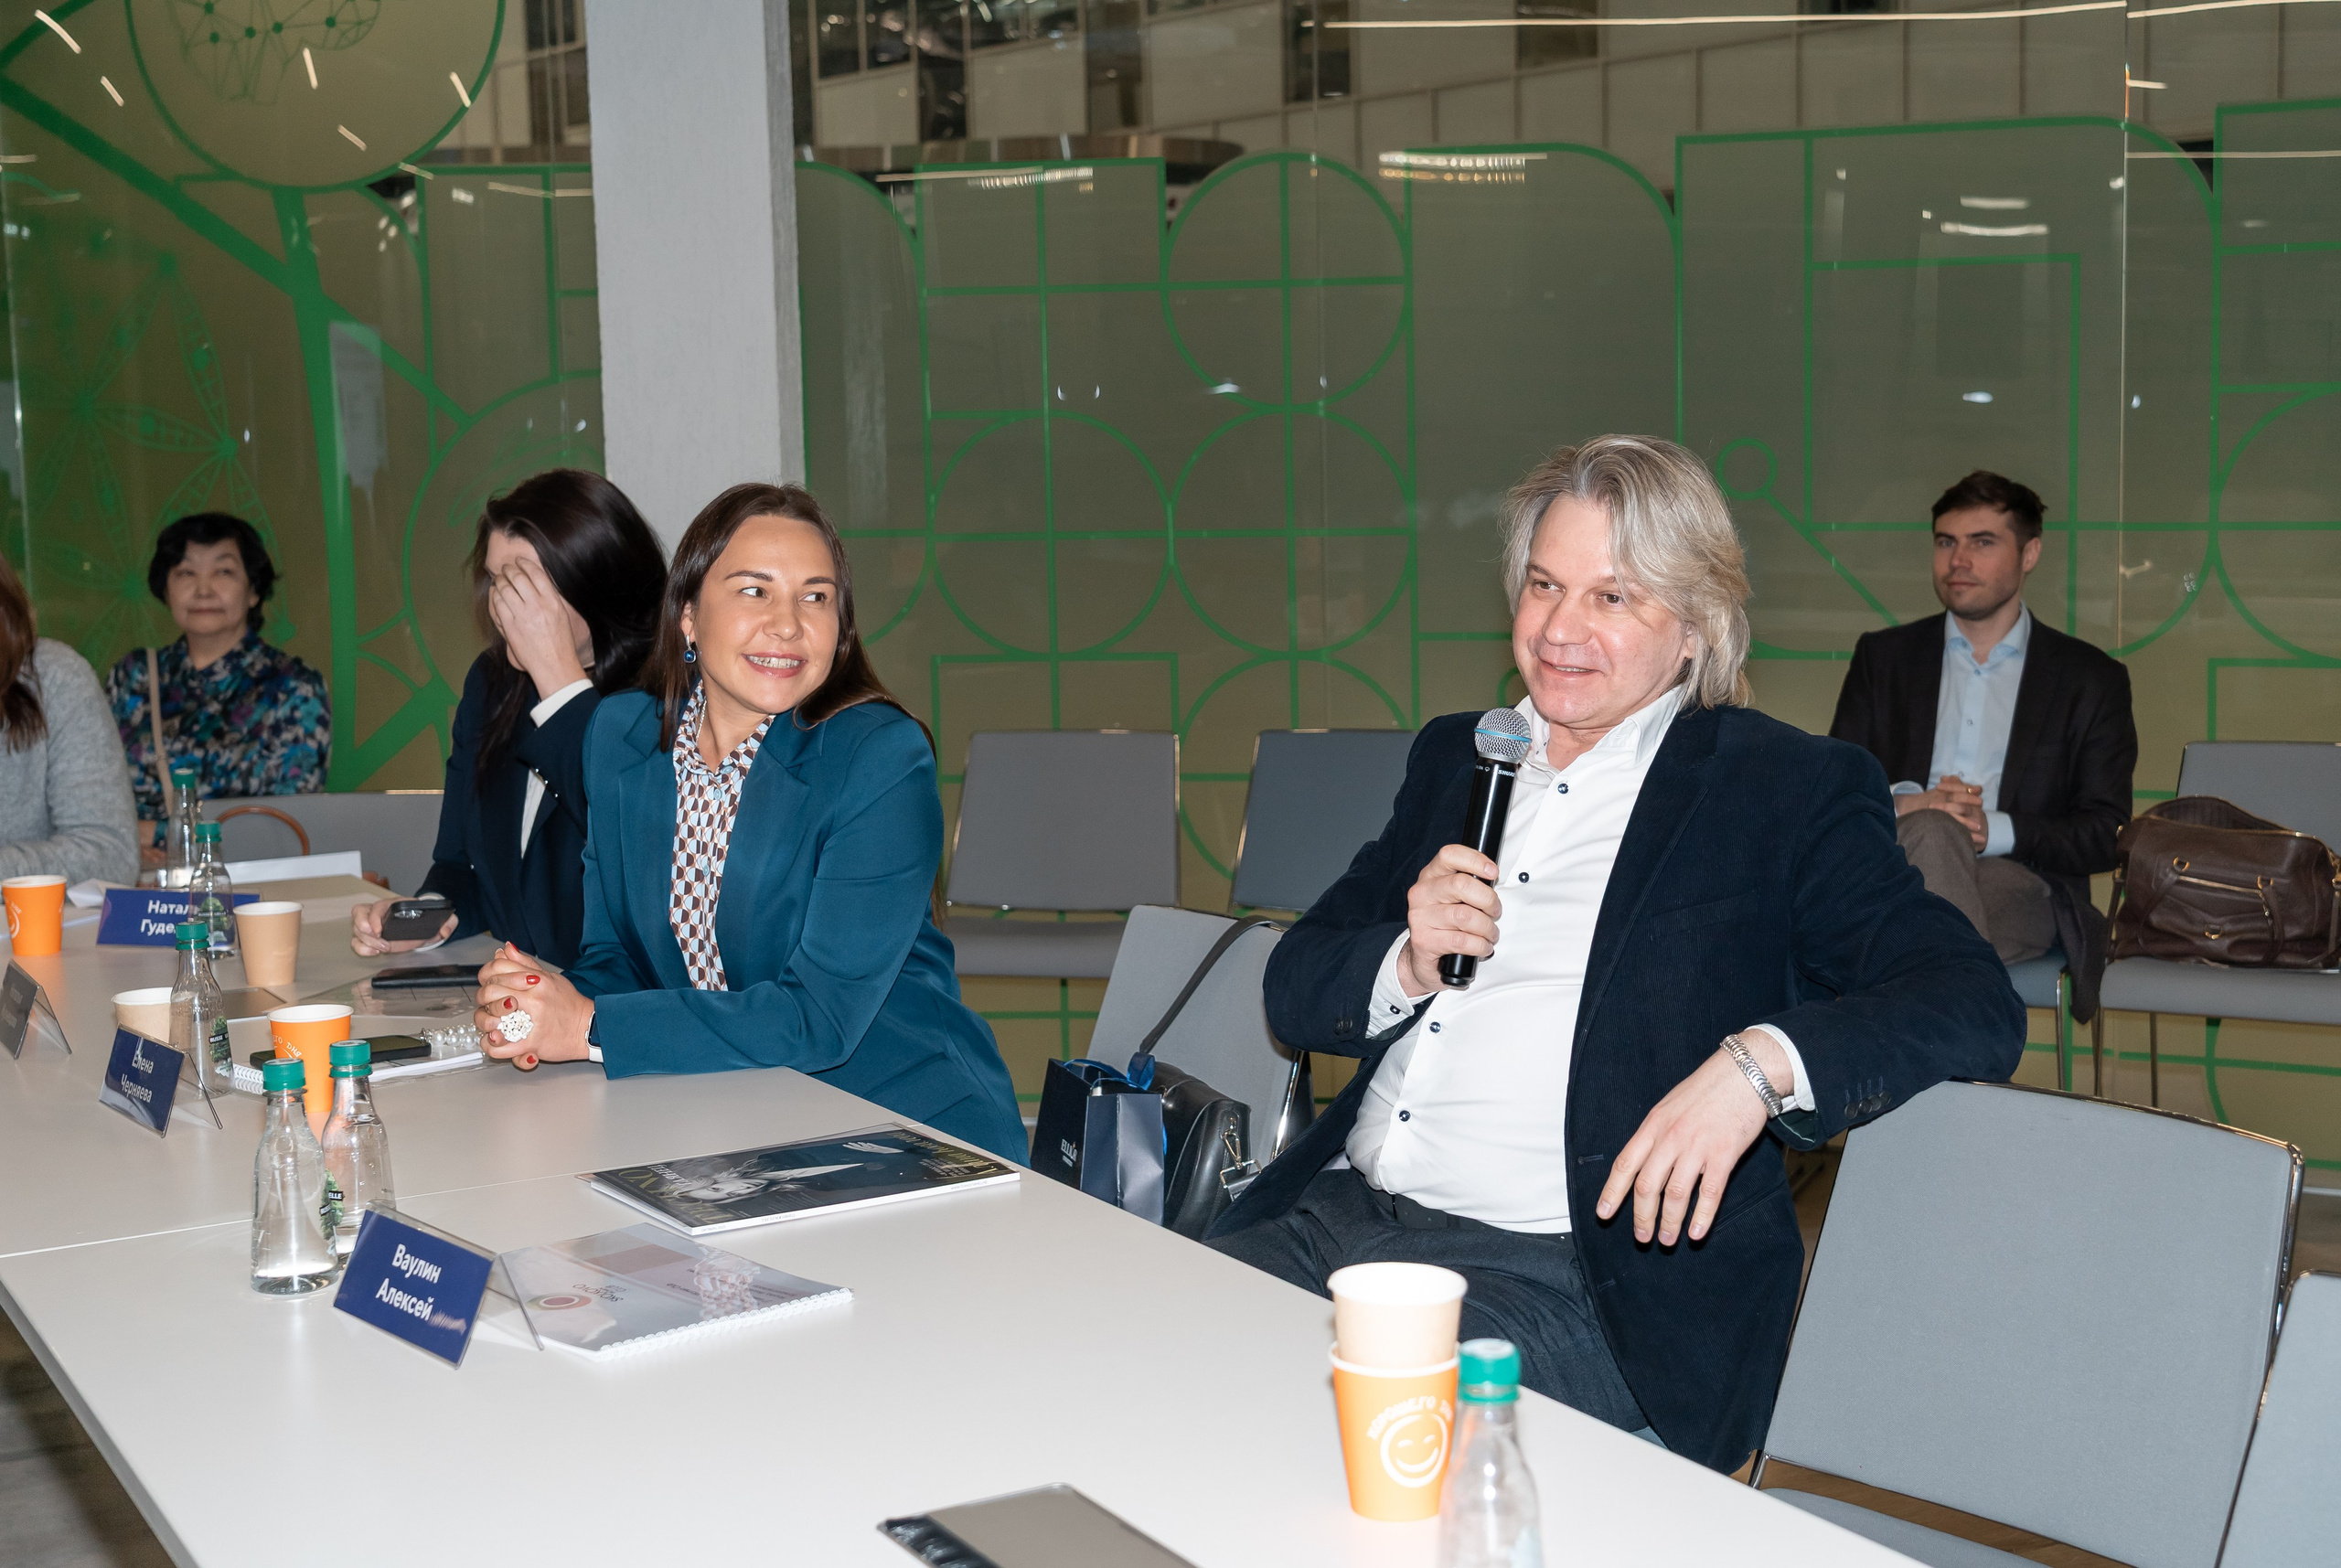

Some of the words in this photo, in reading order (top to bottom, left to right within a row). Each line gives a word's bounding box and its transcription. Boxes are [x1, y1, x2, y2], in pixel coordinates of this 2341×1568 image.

[132, 1050, 155, 1074] Елена
[121, 1073, 153, 1104] Черняева
[391, 1243, 443, 1284] Ваулин
[375, 1277, 435, 1321] Алексей
